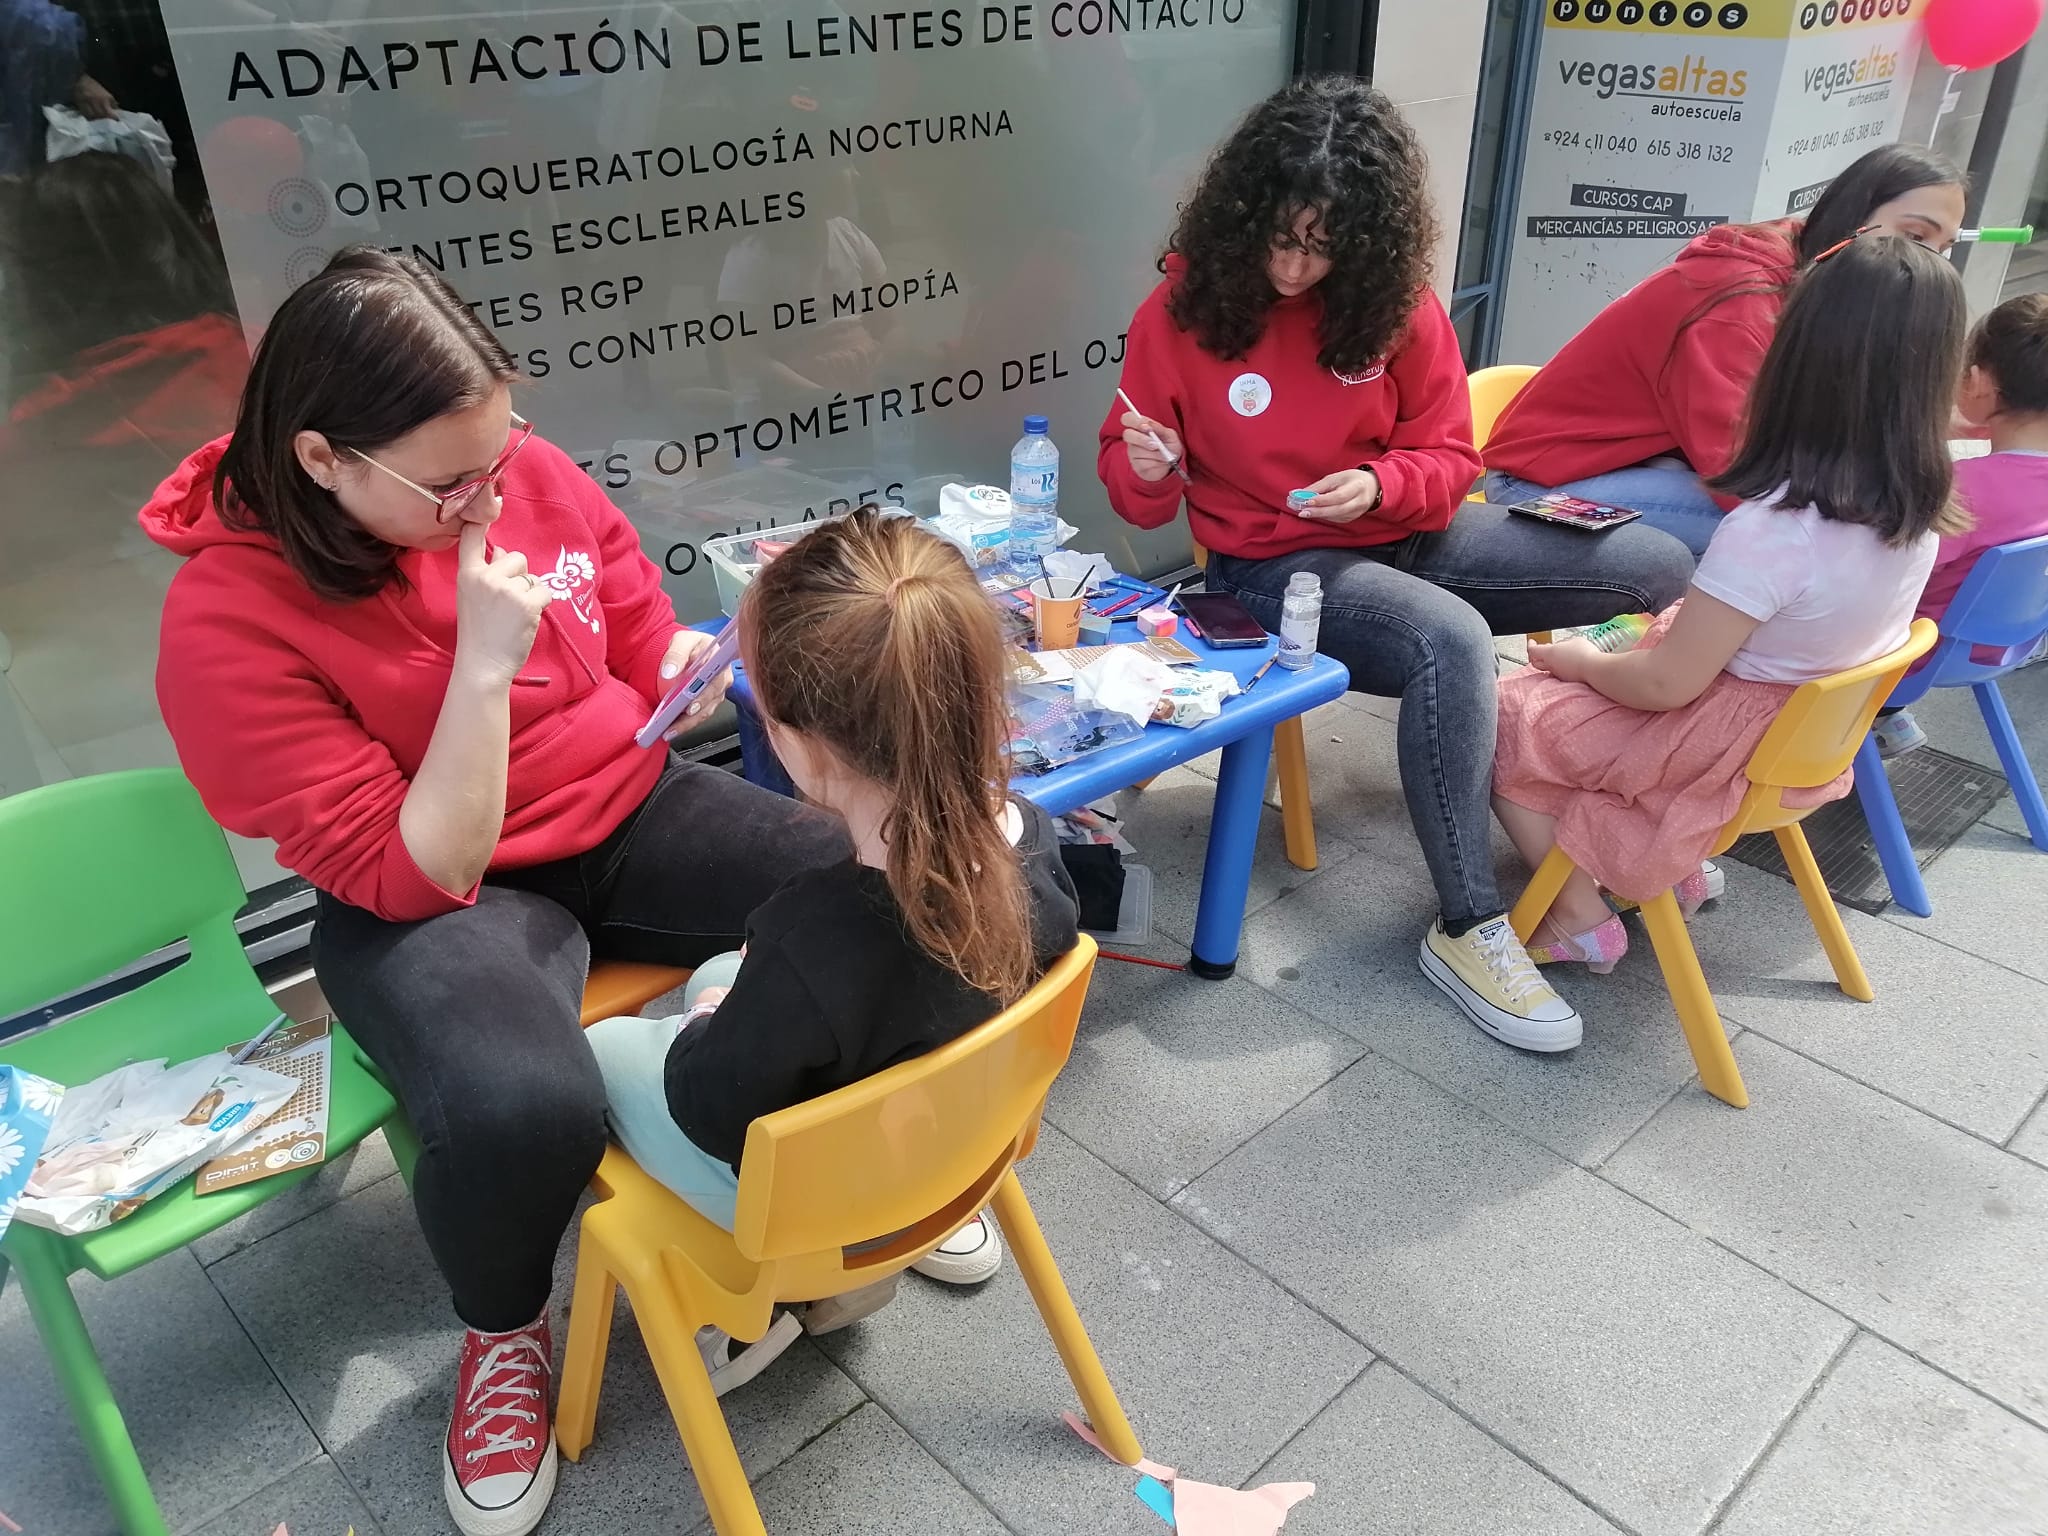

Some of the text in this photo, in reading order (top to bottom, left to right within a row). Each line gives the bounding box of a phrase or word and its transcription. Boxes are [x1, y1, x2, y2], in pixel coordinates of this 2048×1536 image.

[1559, 0, 1741, 24] puntos
[228, 19, 672, 101] ADAPTACIÓN
[697, 21, 763, 66] DE
[788, 9, 963, 59] LENTES
[983, 5, 1034, 43] DE
[1651, 101, 1742, 122] autoescuela
[1848, 86, 1890, 107] autoescuela
[1553, 130, 1580, 148] 924
[1607, 135, 1638, 153] 040
[1647, 139, 1671, 157] 615
[1677, 142, 1701, 160] 318
[1707, 144, 1733, 163] 132
[1793, 139, 1809, 156] 924
[1822, 131, 1840, 149] 040
[335, 110, 1014, 217] ORTOQUERATOLOGÍA NOCTURNA
[1582, 189, 1674, 212] CURSOS CAP
[551, 191, 807, 254] ESCLERALES
[1536, 217, 1623, 235] MERCANCÍAS
[560, 275, 644, 316] RGP
[568, 311, 758, 370] CONTROL
[774, 298, 817, 330] DE
[832, 269, 960, 319] MIOPÍA
[654, 369, 985, 476] OPTOMÉTRICO
[1002, 350, 1069, 392] DEL
